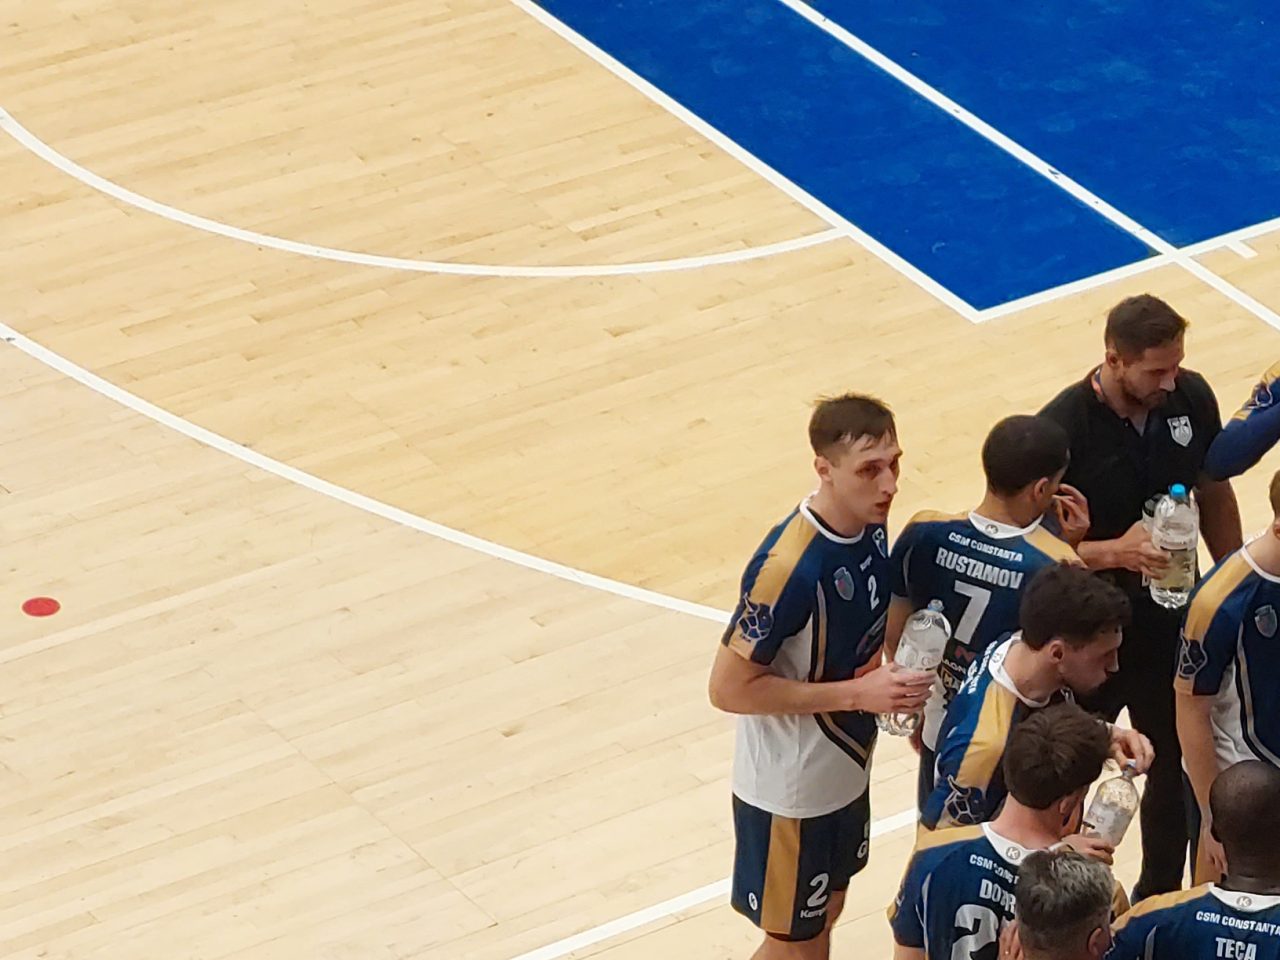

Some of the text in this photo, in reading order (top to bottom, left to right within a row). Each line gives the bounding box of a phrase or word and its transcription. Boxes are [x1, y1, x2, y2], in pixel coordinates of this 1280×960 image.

[948, 531, 970, 547] CSM
[935, 546, 1024, 589] RUSTAMOV
[867, 575, 880, 610] 2
[953, 579, 993, 645] 7
[969, 854, 992, 870] CSM
[806, 872, 829, 907] 2
[1196, 911, 1220, 924] CSM
